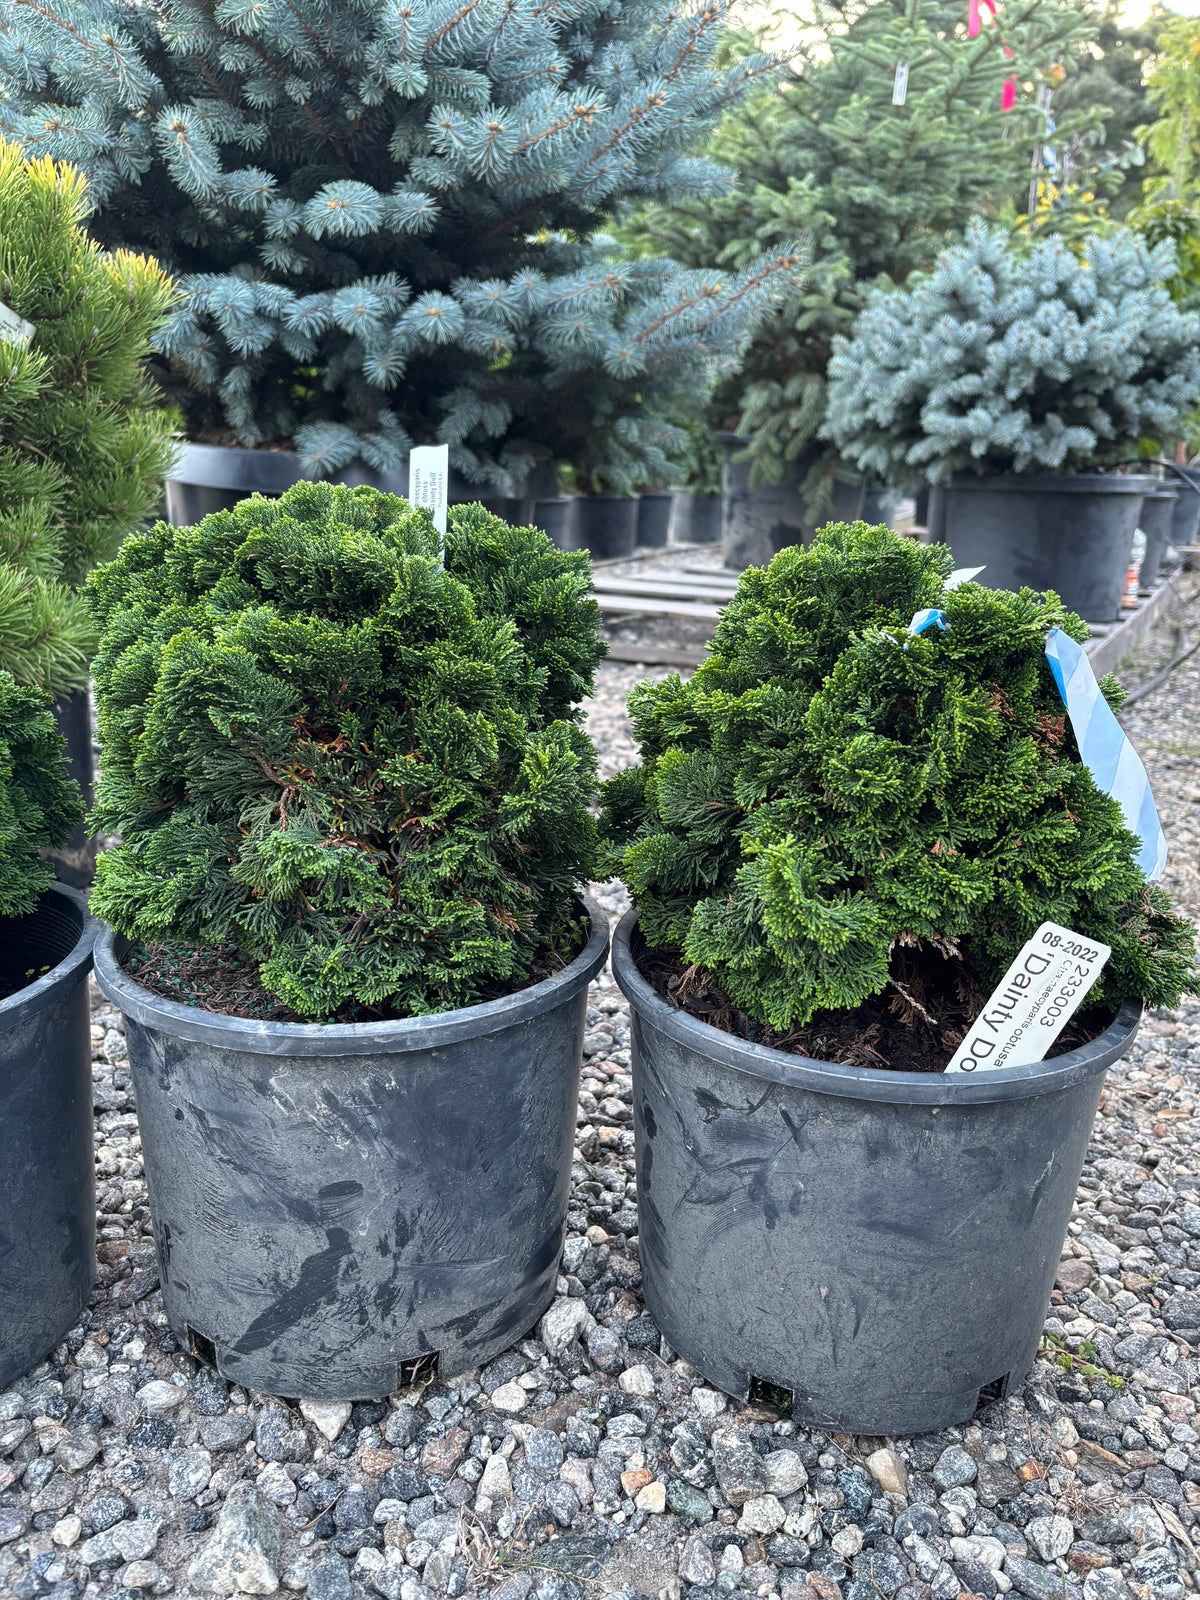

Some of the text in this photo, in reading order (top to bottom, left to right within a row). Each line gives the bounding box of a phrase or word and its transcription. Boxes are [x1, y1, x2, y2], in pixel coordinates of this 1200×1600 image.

[1041, 931, 1099, 963] 08-2022
[1040, 965, 1090, 1027] 233003
[960, 1037, 996, 1073] Do
[993, 1028, 1023, 1067] obtusa
